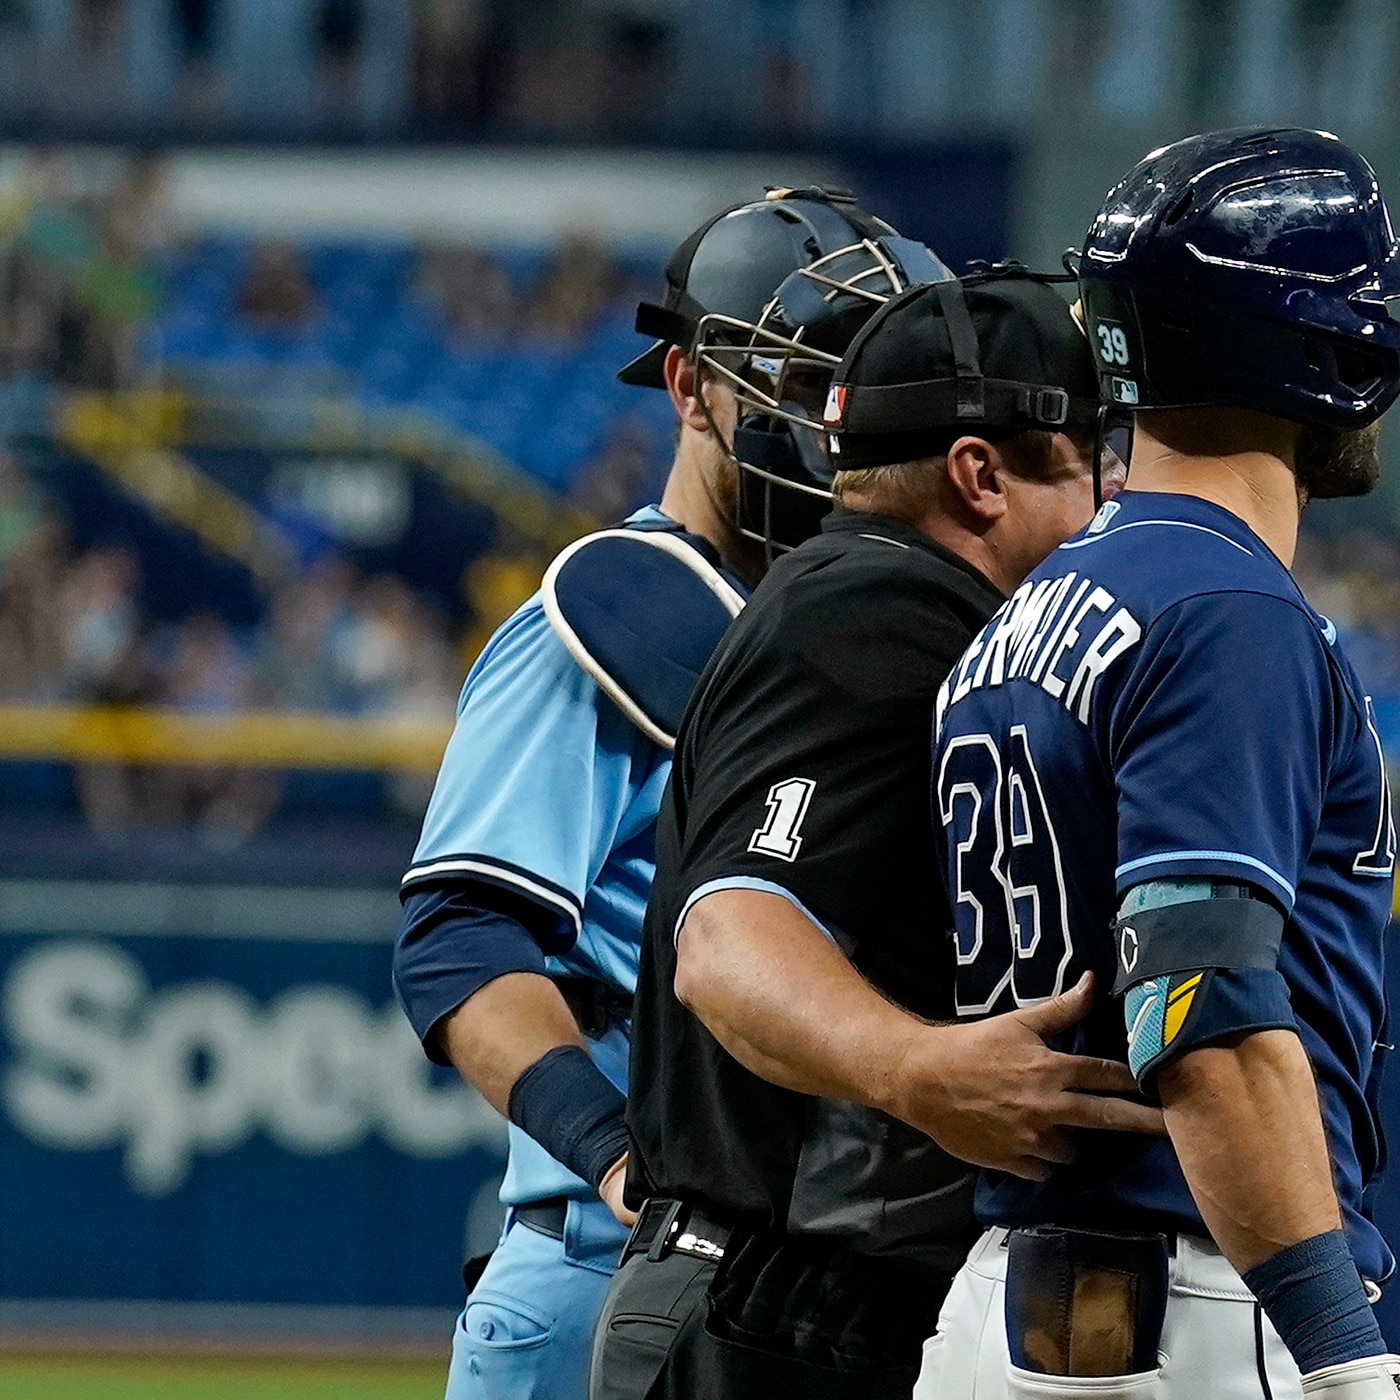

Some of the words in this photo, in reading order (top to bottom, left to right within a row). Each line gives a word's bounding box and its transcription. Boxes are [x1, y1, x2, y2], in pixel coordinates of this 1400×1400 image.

[1097, 324, 1130, 366] 39
[747, 776, 817, 863] 1
[938, 723, 1073, 1017] 39
